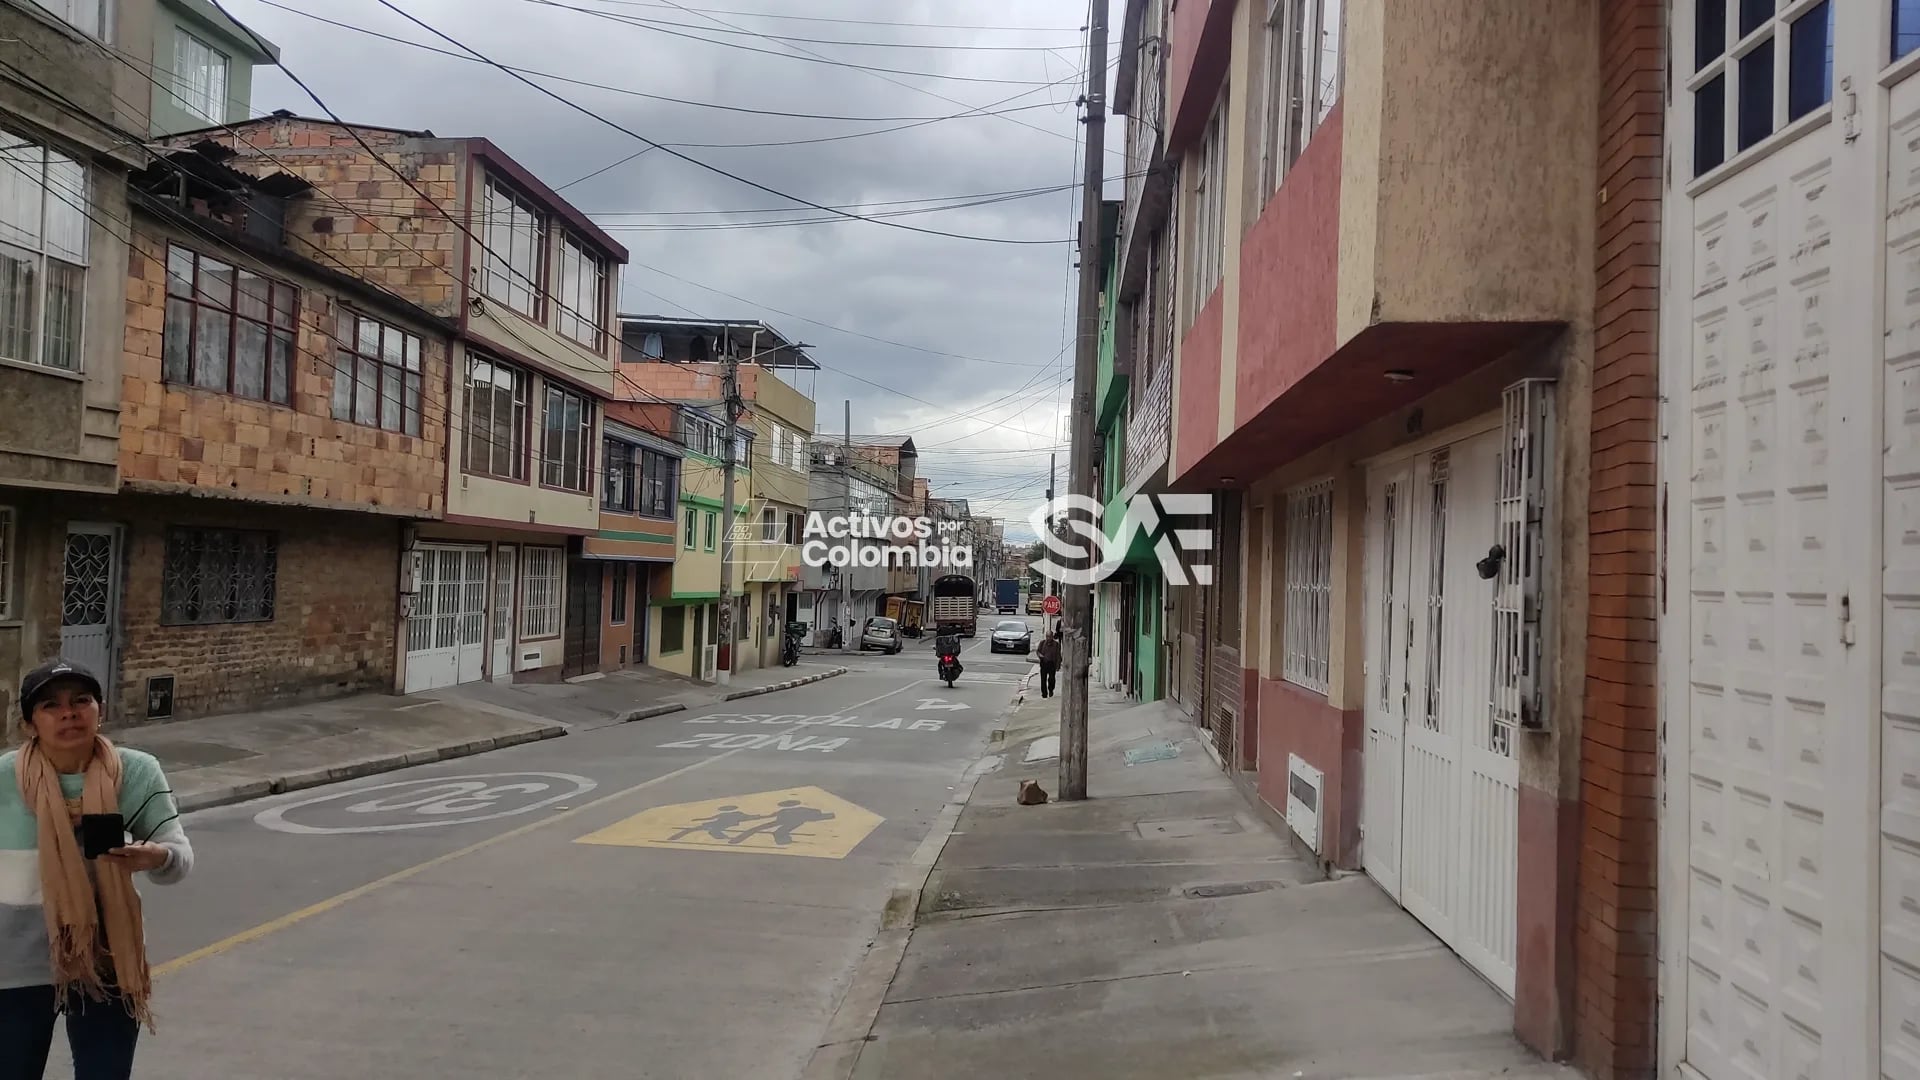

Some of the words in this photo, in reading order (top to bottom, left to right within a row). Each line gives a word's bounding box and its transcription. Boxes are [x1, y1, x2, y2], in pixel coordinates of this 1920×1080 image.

[1043, 601, 1059, 609] PARE
[682, 713, 947, 732] ESCOLAR
[656, 733, 851, 753] ZONA
